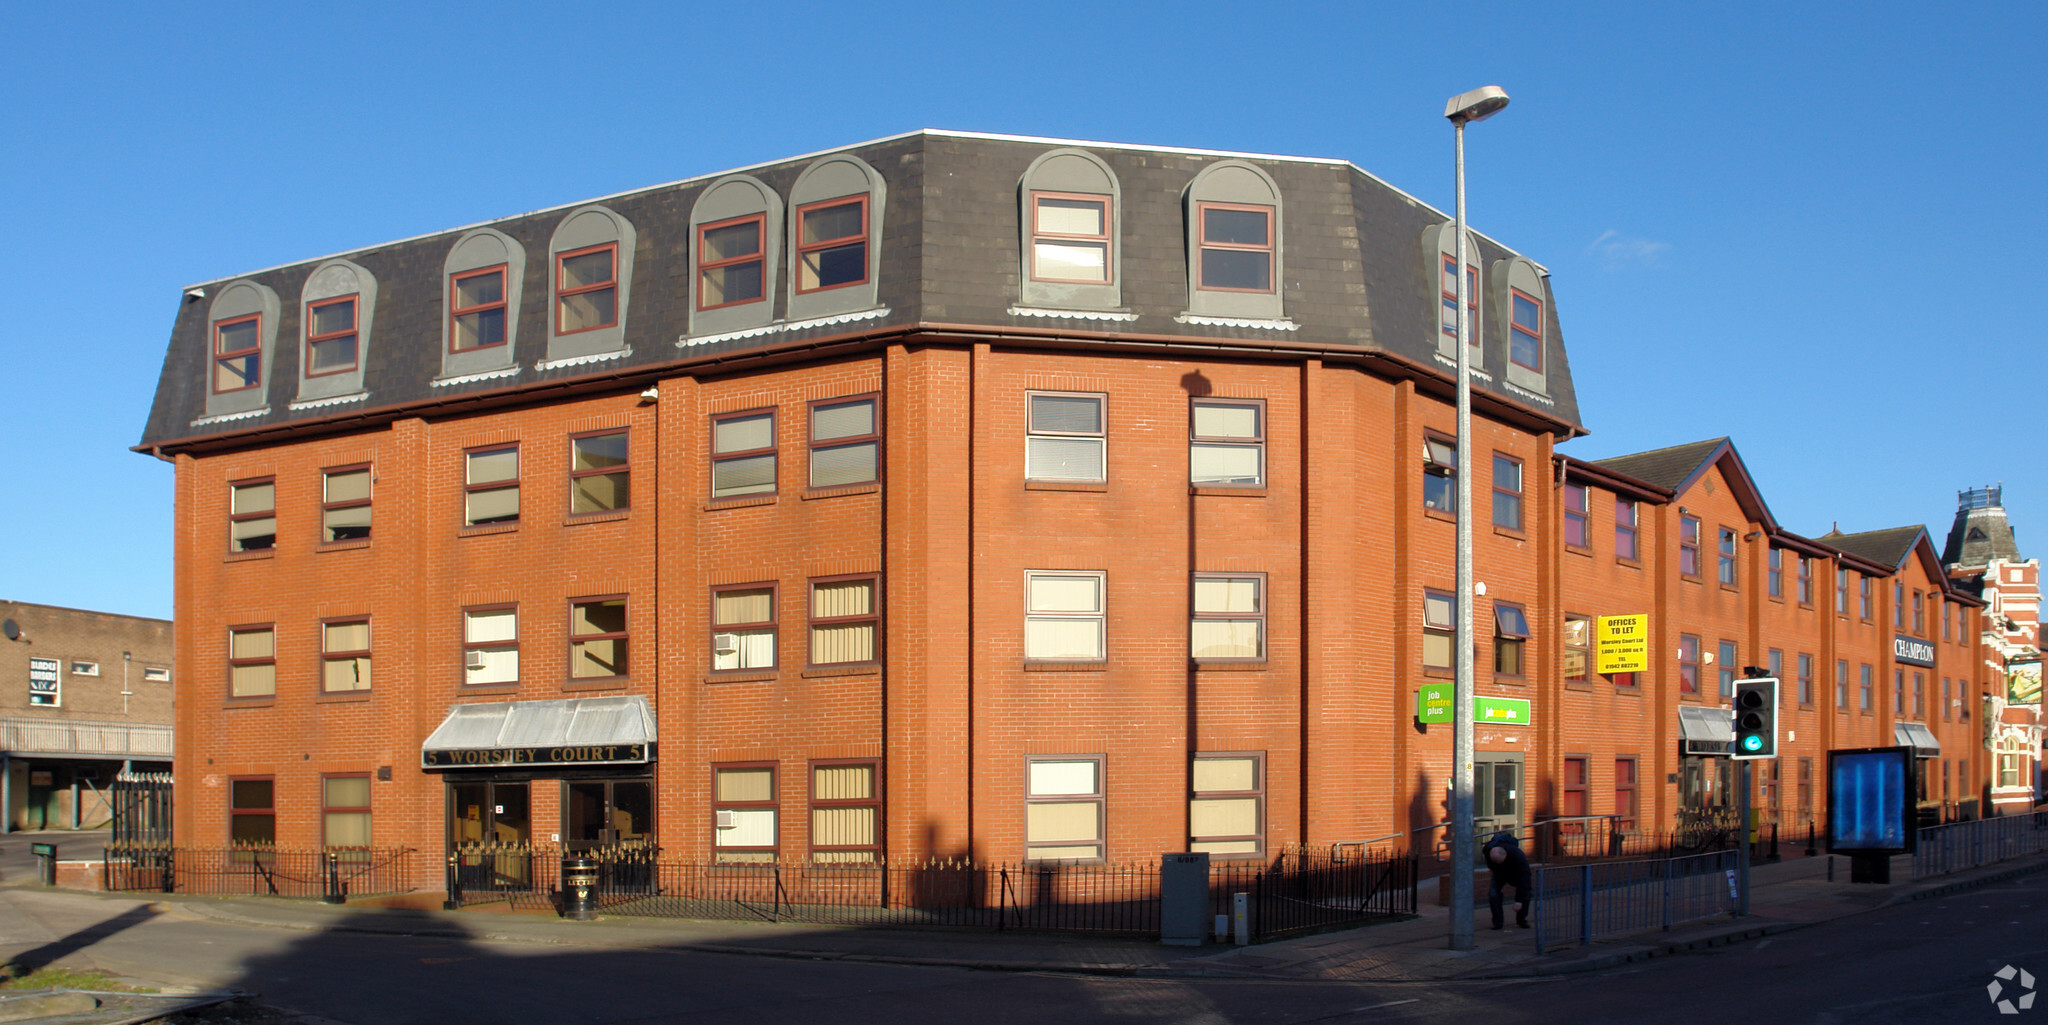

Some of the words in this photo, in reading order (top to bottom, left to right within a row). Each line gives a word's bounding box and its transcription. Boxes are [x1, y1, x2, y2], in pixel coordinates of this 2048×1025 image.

[1894, 639, 1934, 662] CHAMPION
[1427, 691, 1440, 700] job
[1426, 699, 1452, 707] centre
[1427, 706, 1444, 716] plus
[428, 752, 438, 765] 5
[449, 749, 537, 765] WORSLEY
[550, 746, 618, 762] COURT
[629, 745, 641, 760] 5
